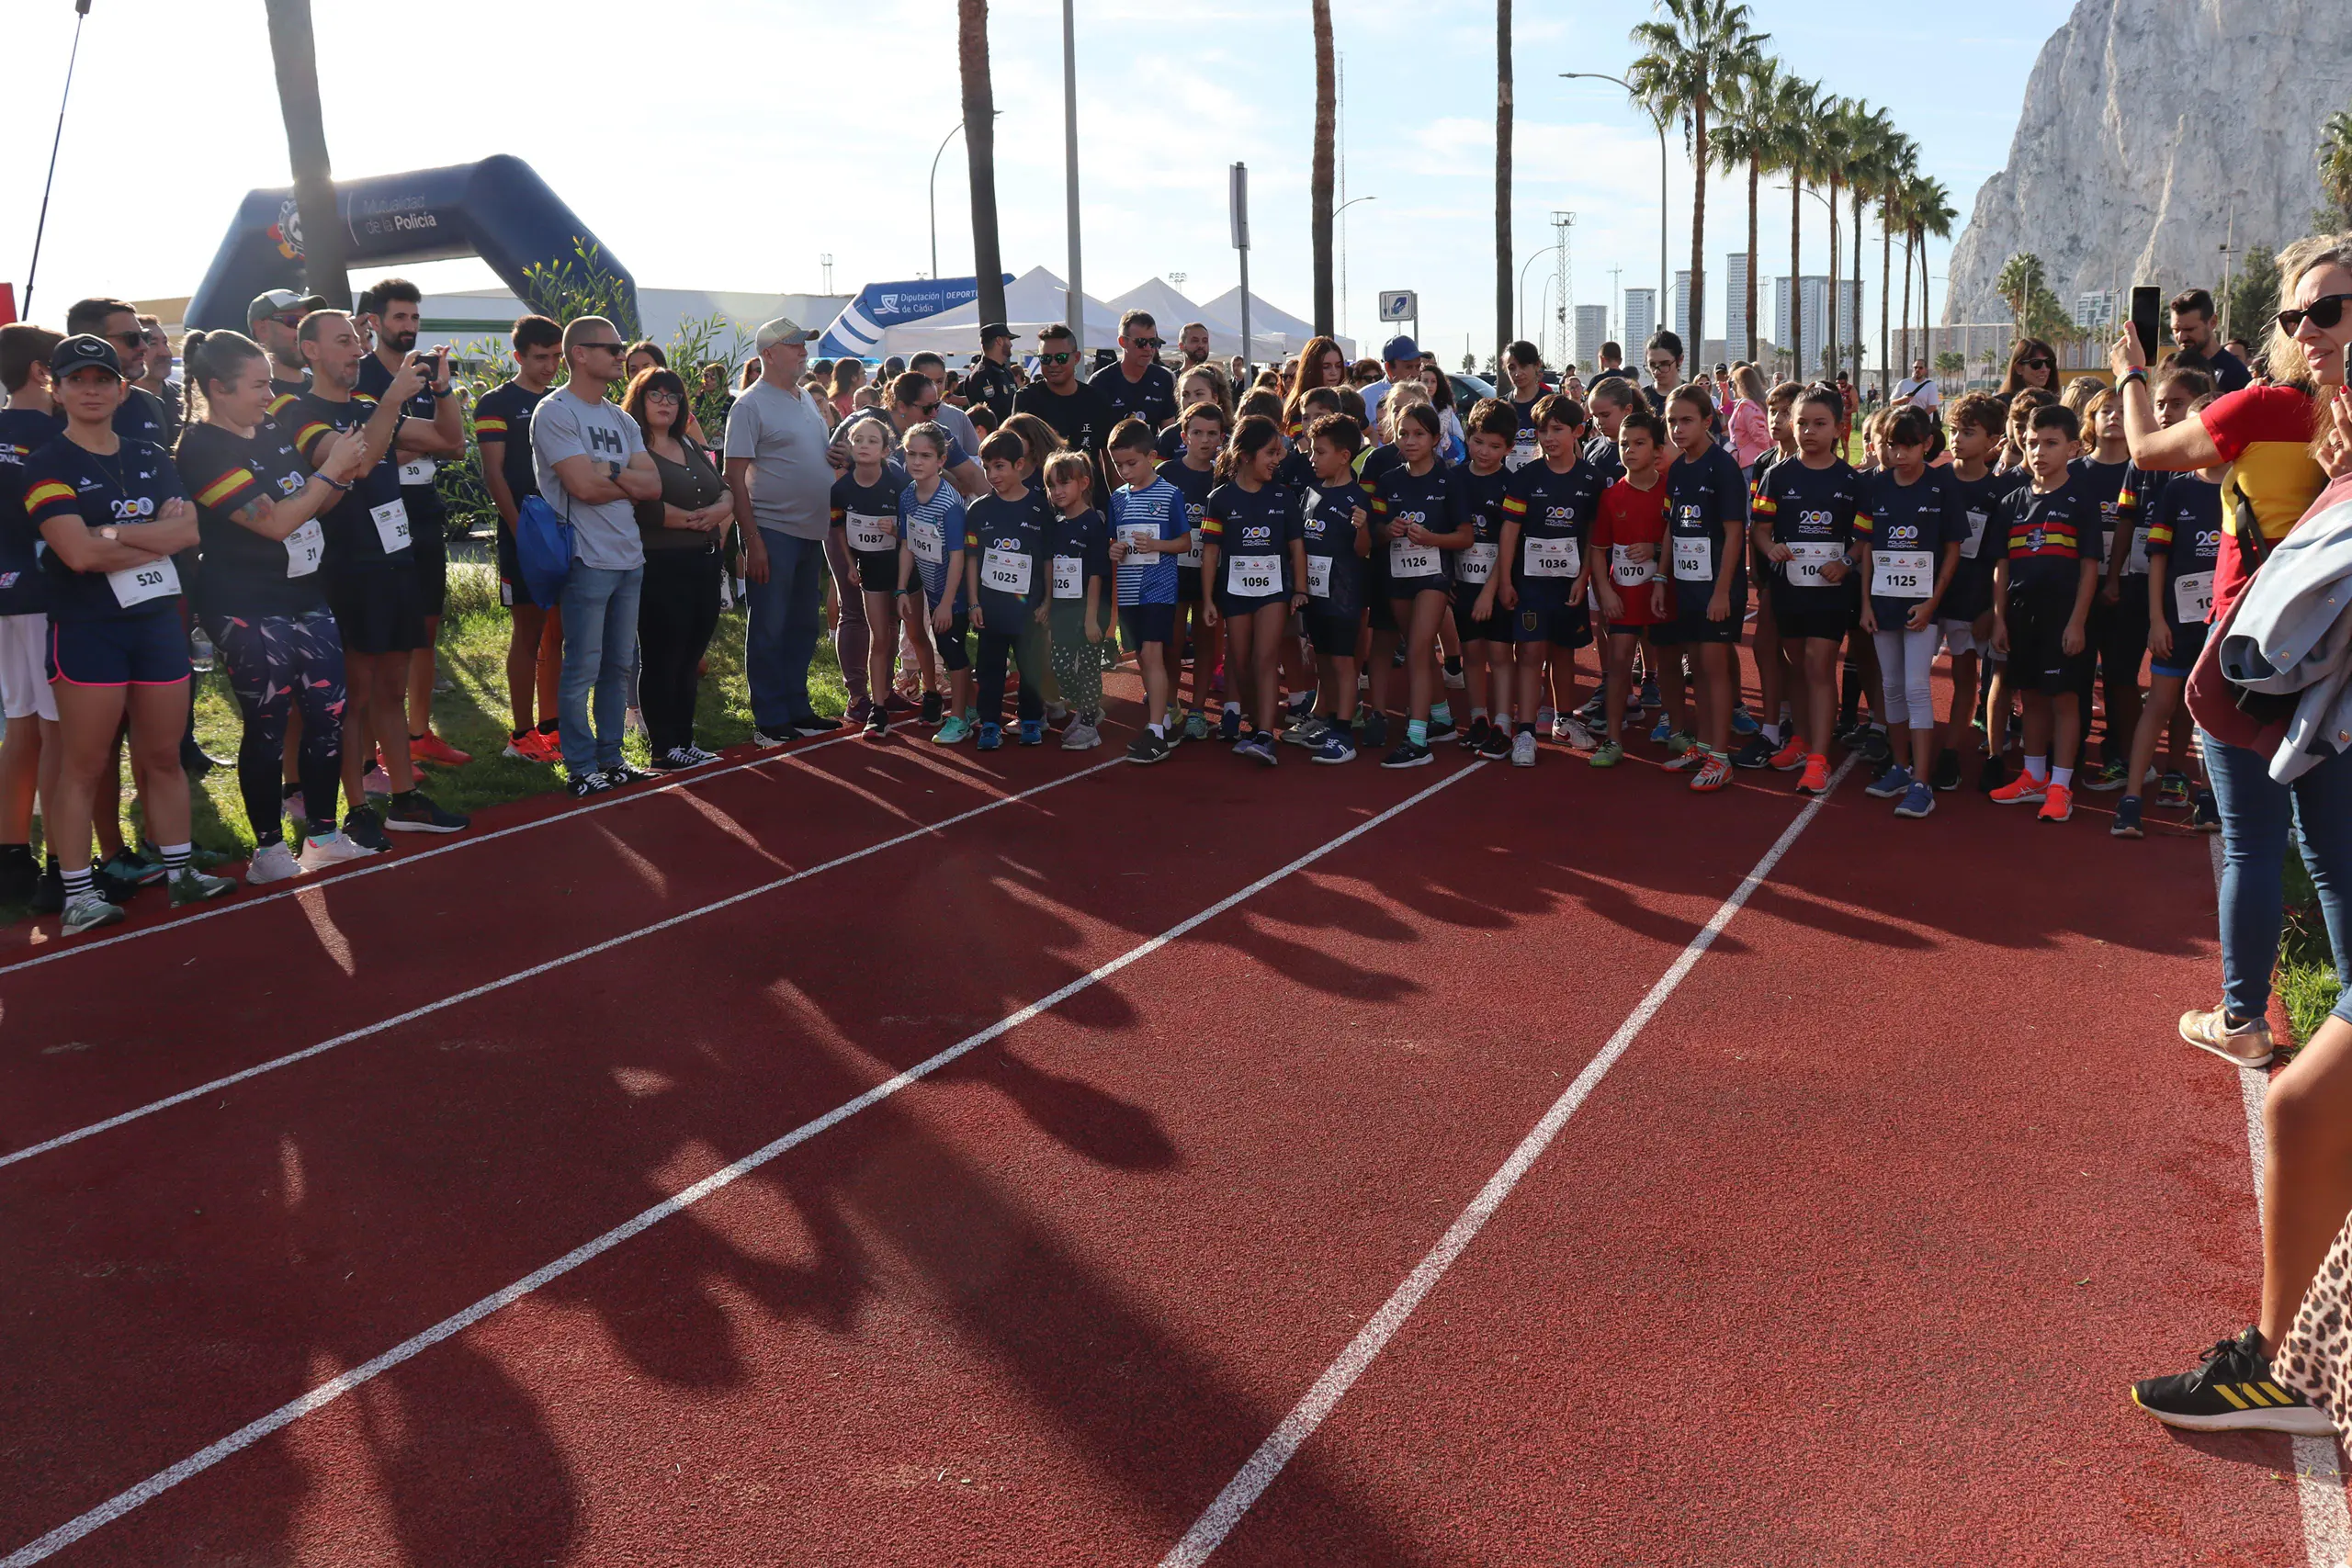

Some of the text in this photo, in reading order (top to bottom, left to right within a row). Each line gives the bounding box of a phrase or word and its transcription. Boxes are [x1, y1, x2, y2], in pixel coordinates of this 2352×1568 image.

[364, 192, 425, 214] Mutualidad
[367, 211, 437, 234] de la Policía
[900, 292, 940, 303] Diputación
[946, 289, 978, 299] DEPORT
[901, 303, 934, 313] de Cádiz
[587, 425, 623, 454] HH
[406, 466, 420, 475] 30
[110, 497, 154, 519] 200
[1546, 506, 1574, 520] 200
[1679, 504, 1702, 519] 200
[1800, 510, 1833, 525] 200
[1242, 526, 1271, 539] 200
[1889, 525, 1918, 539] 200
[858, 534, 884, 544] 1087
[913, 537, 932, 553] 1061
[993, 537, 1021, 550] 200
[306, 547, 317, 561] 31
[1401, 557, 1427, 568] 1126
[1462, 562, 1487, 574] 1004
[1539, 558, 1567, 569] 1036
[1678, 559, 1699, 570] 1043
[992, 570, 1018, 584] 1025
[1619, 566, 1645, 577] 1070
[136, 570, 164, 587] 520
[1242, 577, 1270, 587] 1096
[1886, 575, 1917, 587] 1125
